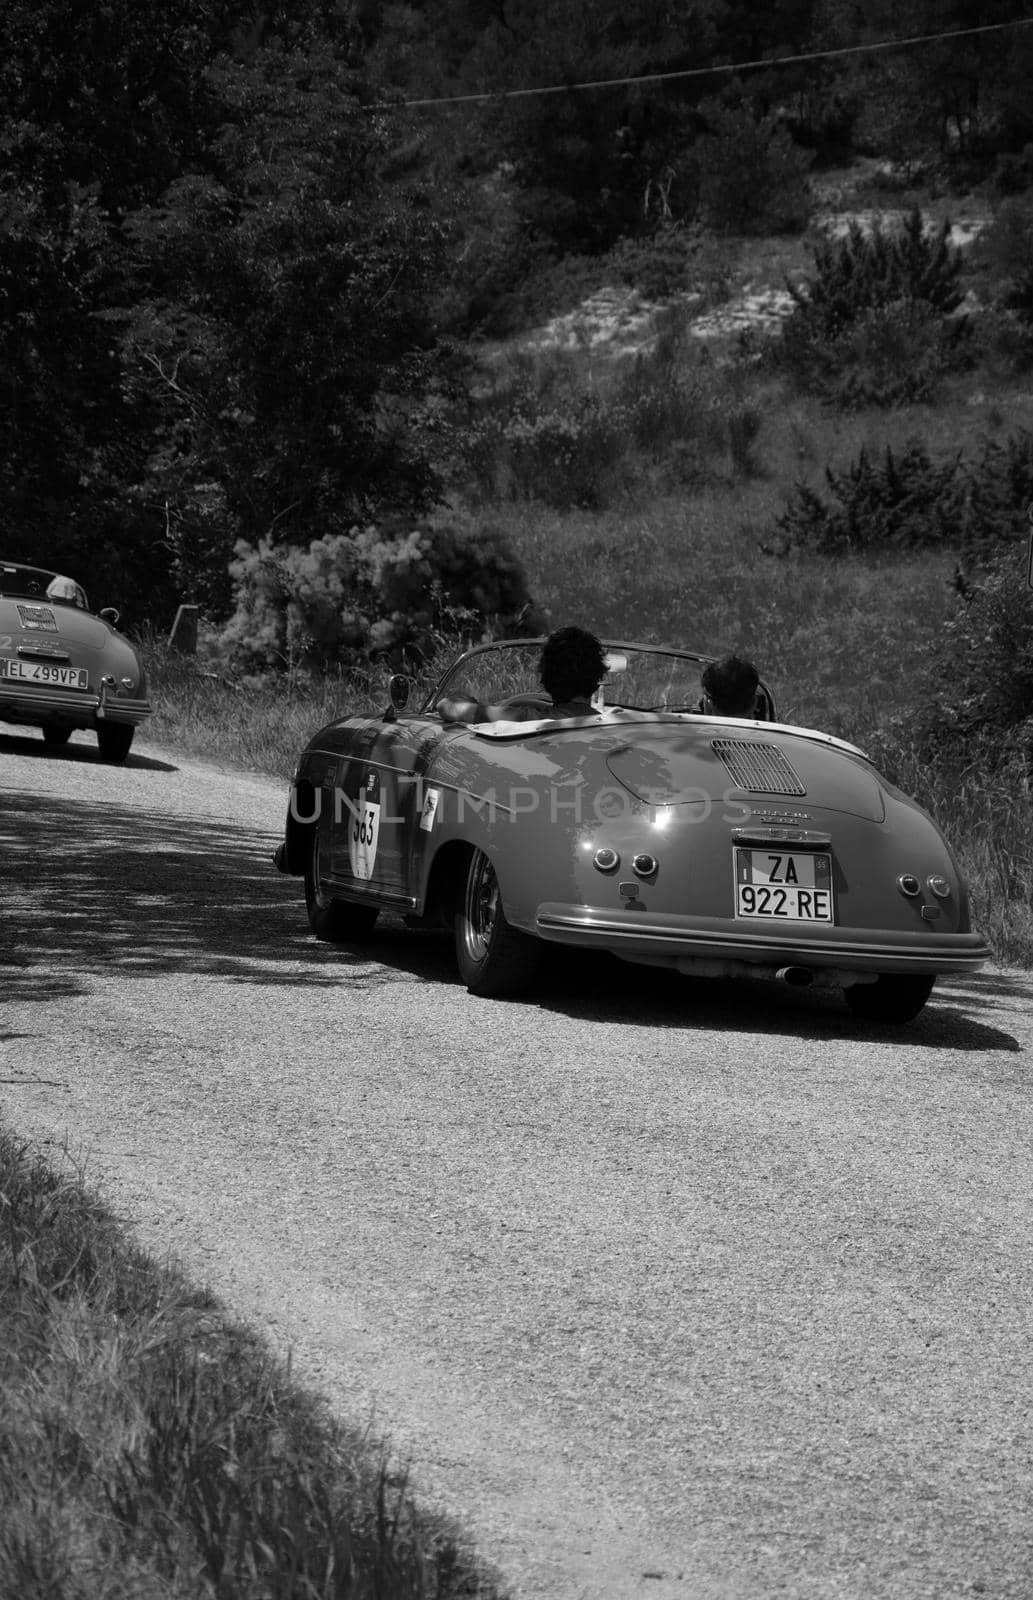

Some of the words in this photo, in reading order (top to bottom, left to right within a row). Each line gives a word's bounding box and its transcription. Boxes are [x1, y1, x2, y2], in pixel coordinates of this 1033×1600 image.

[10, 662, 26, 677] EL
[32, 667, 76, 684] 499VP
[768, 855, 799, 884] ZA
[741, 886, 788, 916] 922
[797, 890, 829, 919] RE
